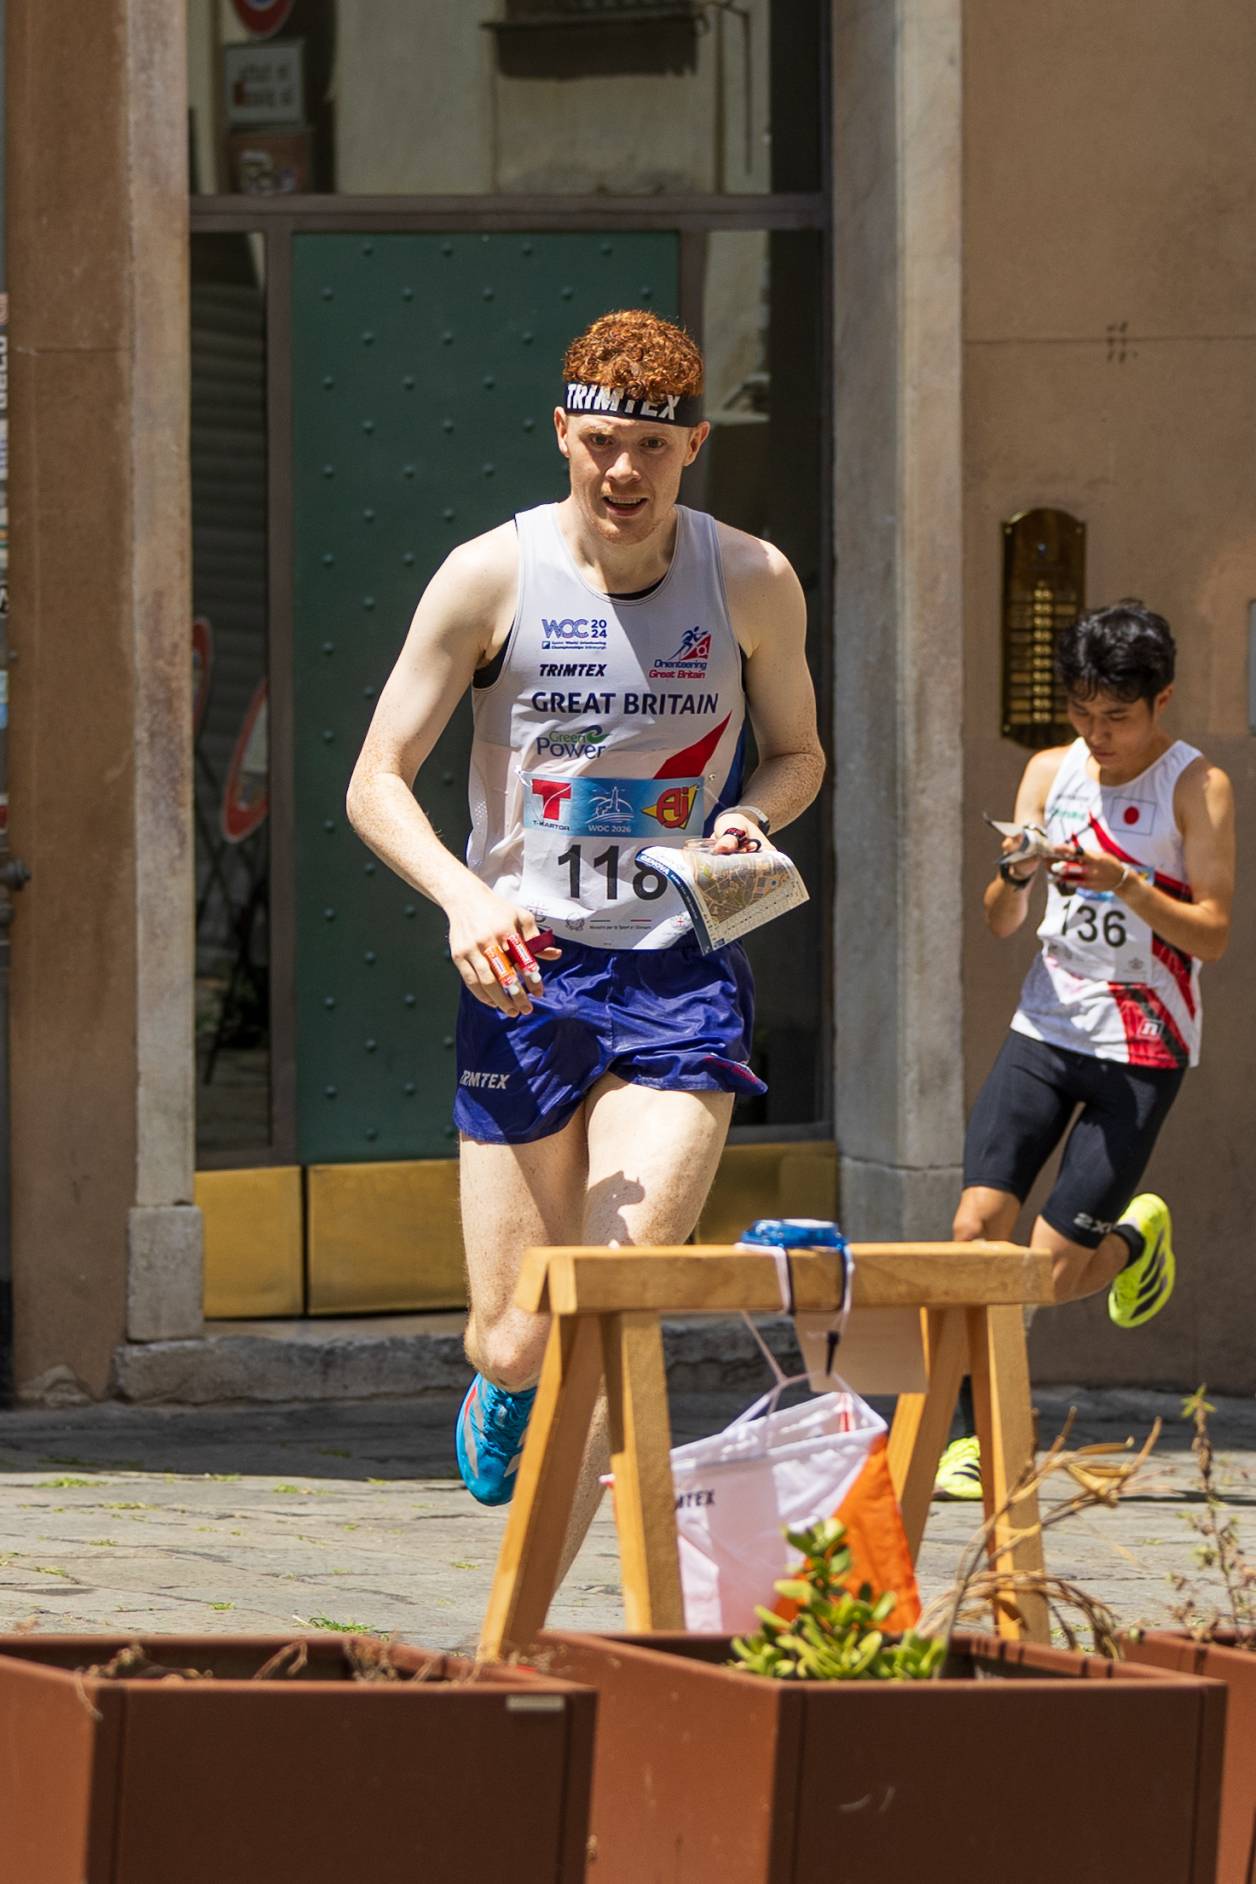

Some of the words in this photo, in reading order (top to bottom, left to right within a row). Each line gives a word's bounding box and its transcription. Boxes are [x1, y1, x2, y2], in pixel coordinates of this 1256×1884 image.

[541, 618, 589, 639] WOC
[590, 619, 607, 629] 20
[590, 629, 607, 639] 24
[539, 663, 608, 678] TRIMTEX
[649, 669, 675, 679] Great
[677, 669, 706, 679] Britain
[531, 691, 617, 715] GREAT
[623, 692, 719, 715] BRITAIN
[550, 730, 587, 744] Green
[536, 736, 607, 760] Power
[587, 824, 610, 833] WOC
[558, 844, 668, 901] 118
[1061, 899, 1127, 948] 136
